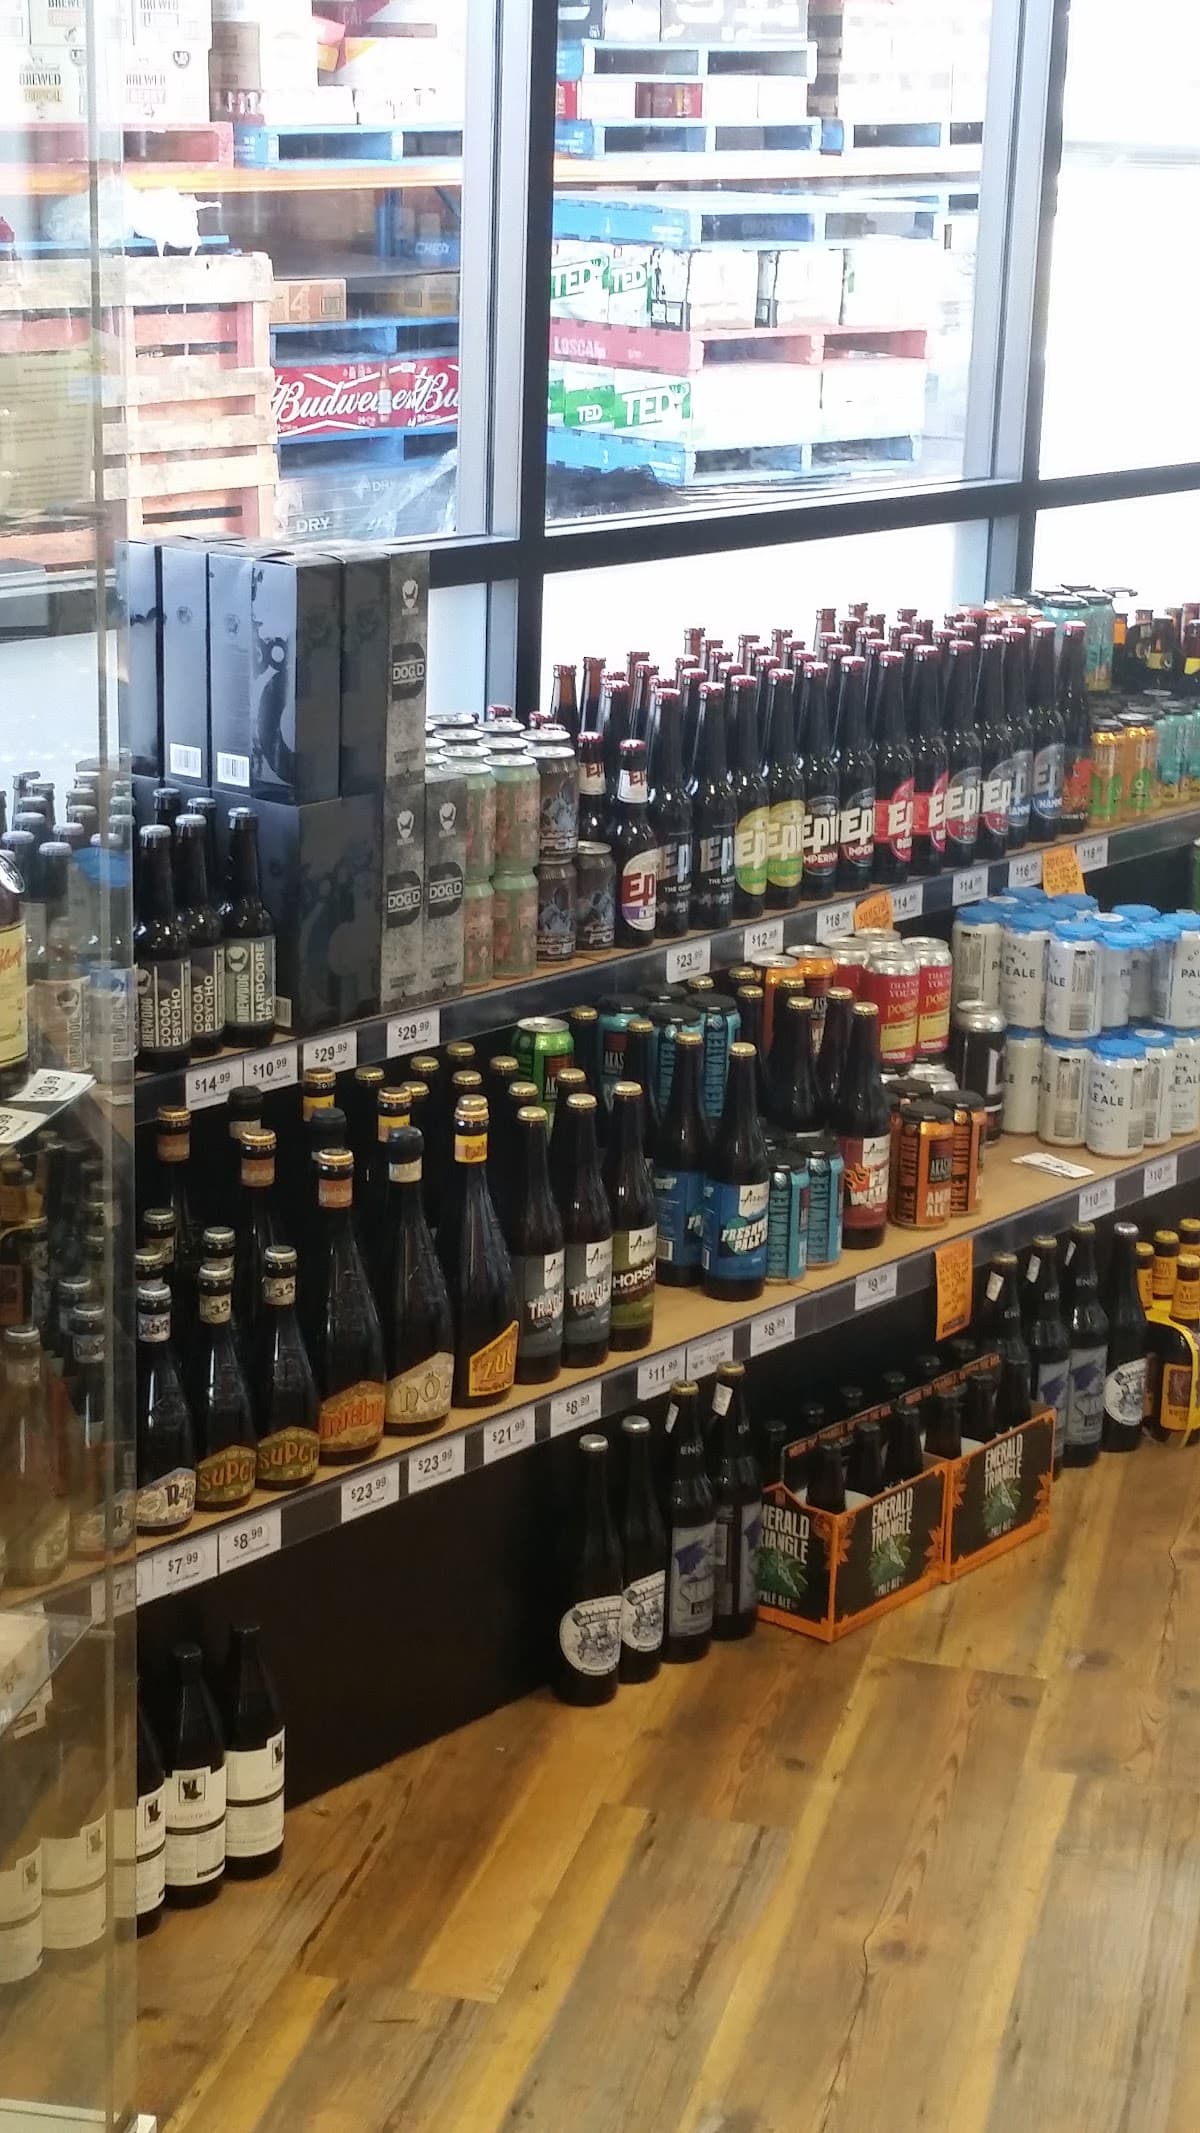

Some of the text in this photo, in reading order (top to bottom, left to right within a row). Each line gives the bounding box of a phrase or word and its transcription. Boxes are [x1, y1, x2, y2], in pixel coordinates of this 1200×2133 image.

[18, 74, 62, 86] BREWED
[552, 268, 592, 298] TED
[611, 270, 646, 293] TED
[271, 376, 416, 424] Budweier
[577, 404, 603, 422] TED
[622, 393, 672, 425] TED
[255, 942, 266, 1022] HARDCORE
[193, 984, 204, 1033] COCOA
[204, 975, 214, 1032] PSYCHO
[236, 973, 250, 1023] BREWDOG
[263, 997, 273, 1020] IPA
[141, 997, 155, 1048] BREWDOG
[159, 997, 171, 1047] COCOA
[171, 987, 182, 1046] PSYCHO
[397, 1020, 431, 1041] $29.99
[314, 1042, 349, 1062] $29.99
[252, 1057, 288, 1078] $10.99
[194, 1071, 232, 1093] $14.99
[492, 1419, 526, 1445] $21.99
[417, 1448, 454, 1475] $23.99
[985, 1433, 1023, 1472] EMERALD
[351, 1476, 387, 1503] $23.99
[871, 1487, 914, 1529] EMERALD
[233, 1525, 263, 1550] $8.99
[871, 1511, 912, 1553] TRIANGLE
[168, 1551, 199, 1576] $7.99
